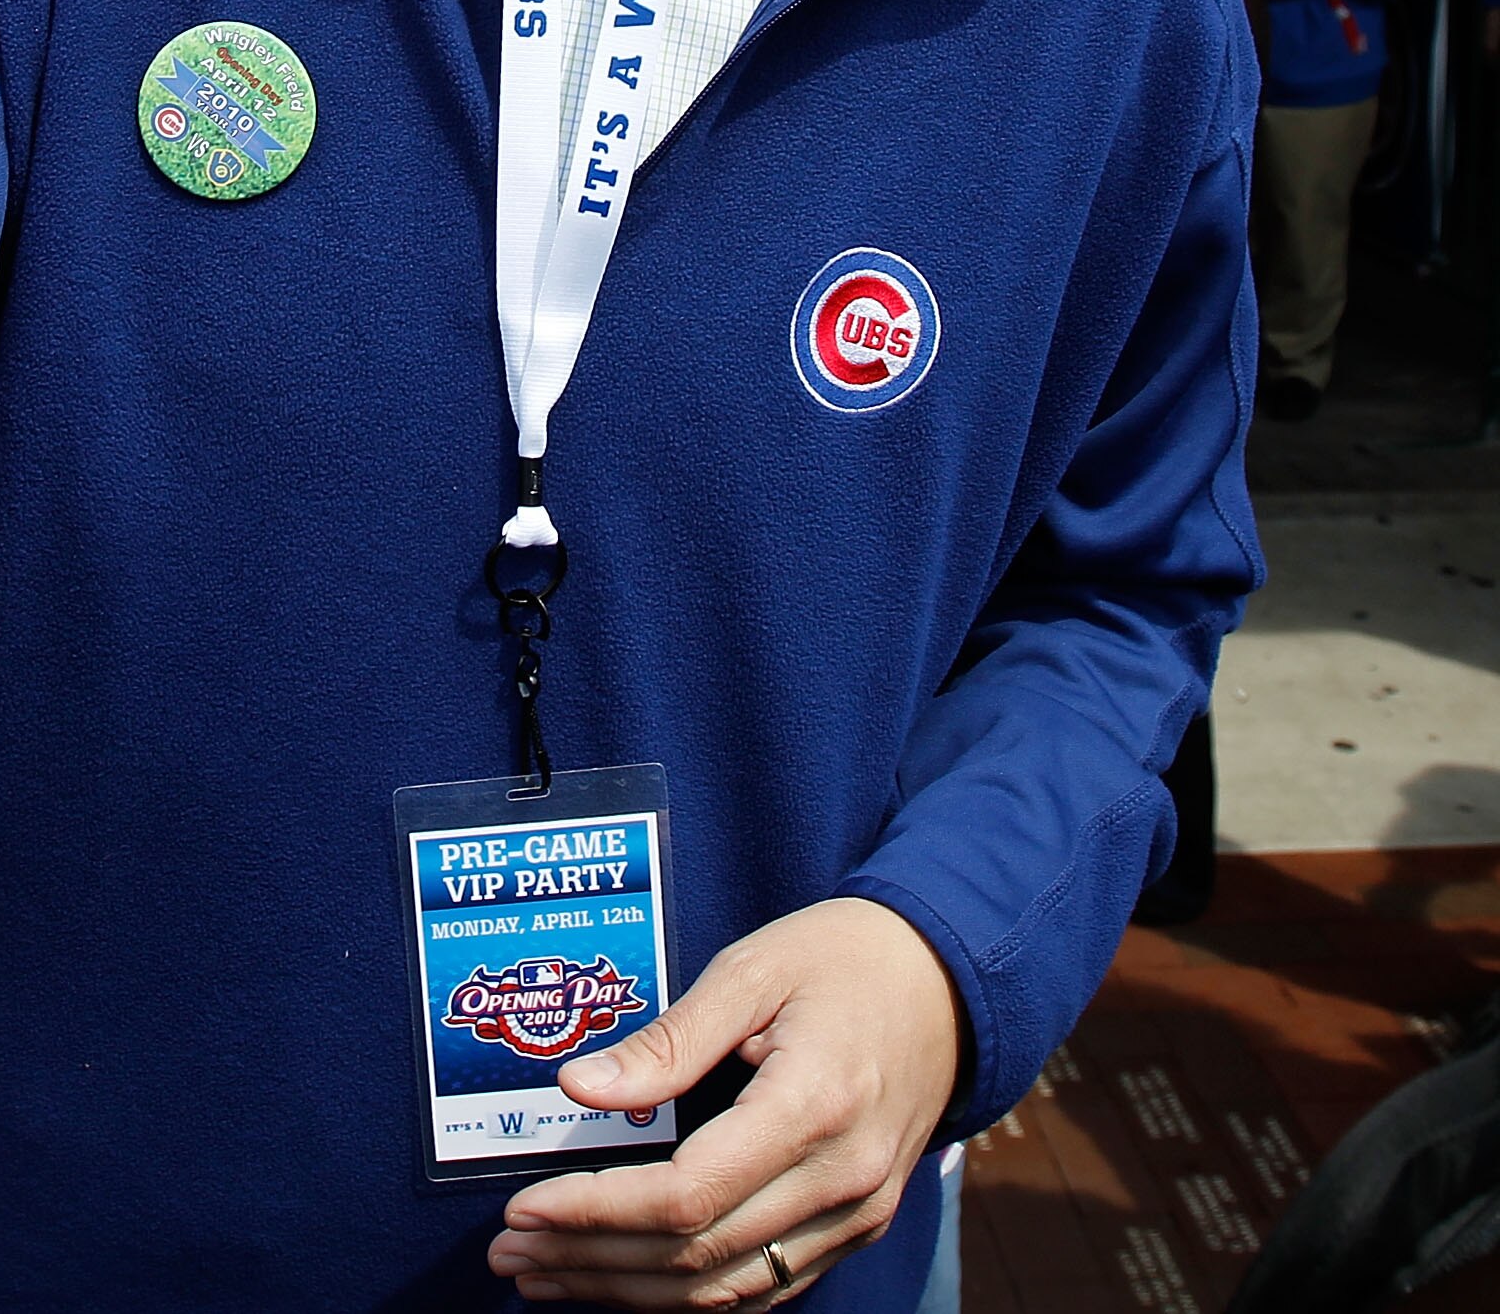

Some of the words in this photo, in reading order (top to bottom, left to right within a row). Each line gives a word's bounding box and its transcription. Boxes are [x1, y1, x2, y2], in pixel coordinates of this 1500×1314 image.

[199, 57, 249, 99] April
[252, 97, 278, 123] 12
[203, 27, 278, 66] Wrigley
[275, 62, 306, 113] Field
[216, 47, 262, 89] Opening
[259, 82, 285, 107] Day
[194, 98, 230, 131] YEAR
[197, 83, 255, 133] 2010
[578, 110, 629, 218] IT'S
[607, 55, 643, 90] A
[438, 827, 628, 872] PRE-GAME
[443, 873, 505, 904] VIP
[514, 861, 629, 899] PARTY
[430, 917, 526, 940] MONDAY,
[531, 910, 595, 932] APRIL
[601, 907, 646, 926] 12th
[523, 1009, 566, 1026] 2010
